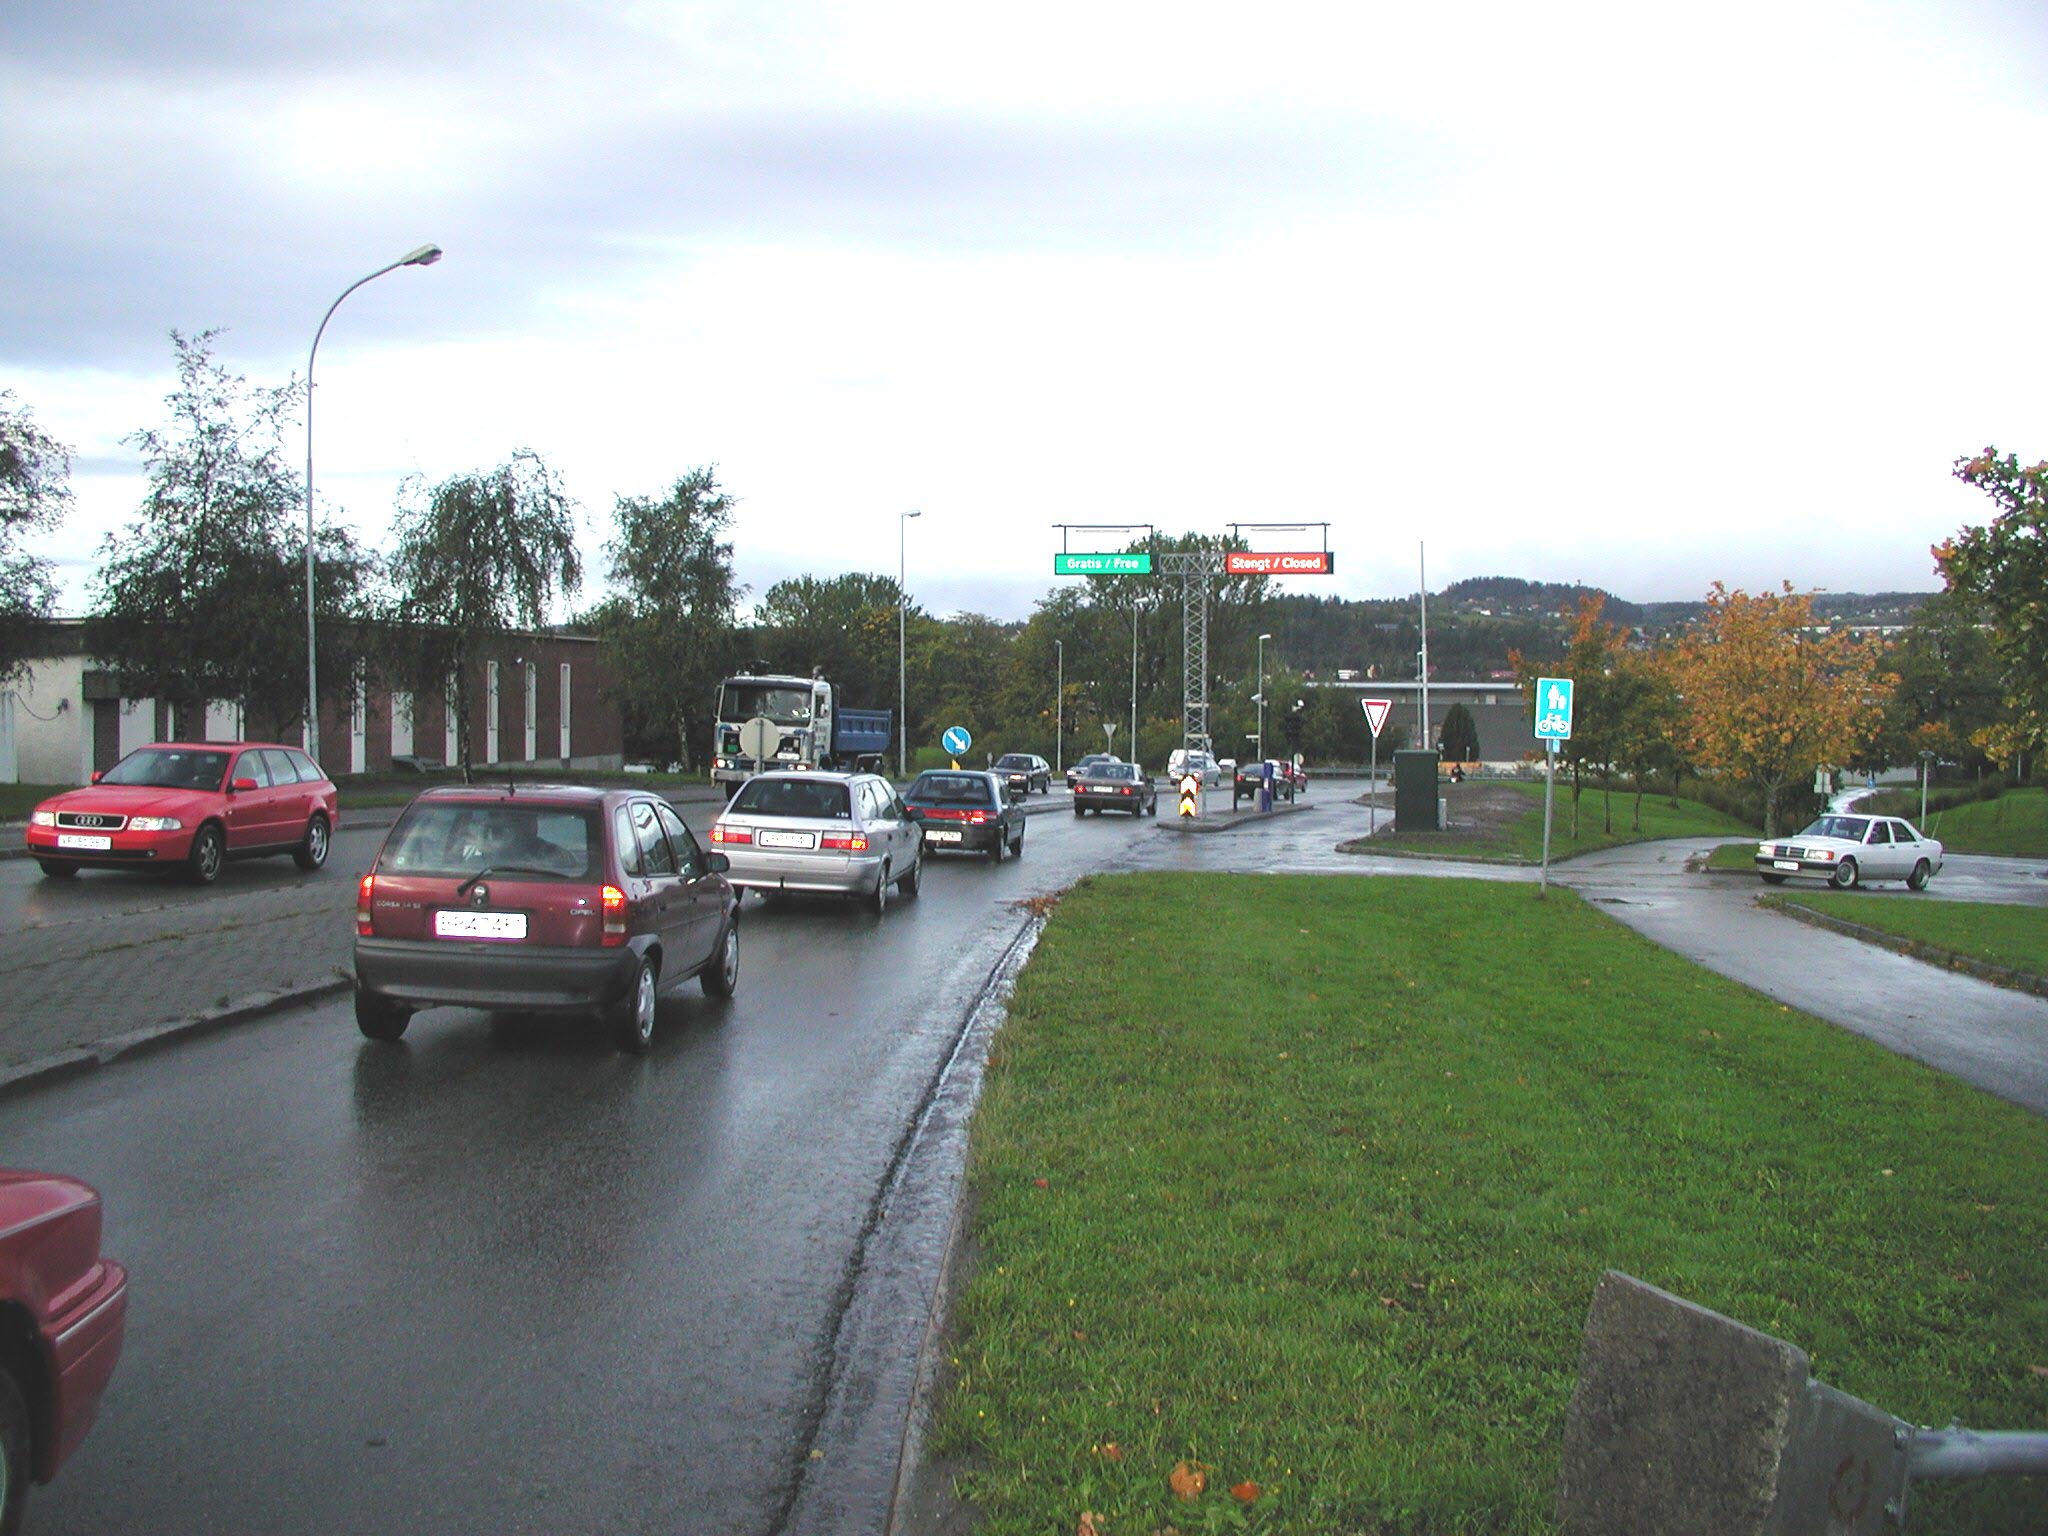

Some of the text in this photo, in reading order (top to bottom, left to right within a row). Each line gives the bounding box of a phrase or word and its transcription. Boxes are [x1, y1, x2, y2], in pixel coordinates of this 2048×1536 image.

[1067, 558, 1102, 569] Gratis
[1113, 558, 1139, 569] Free
[1231, 557, 1271, 571] Stengt
[1281, 557, 1321, 568] Closed
